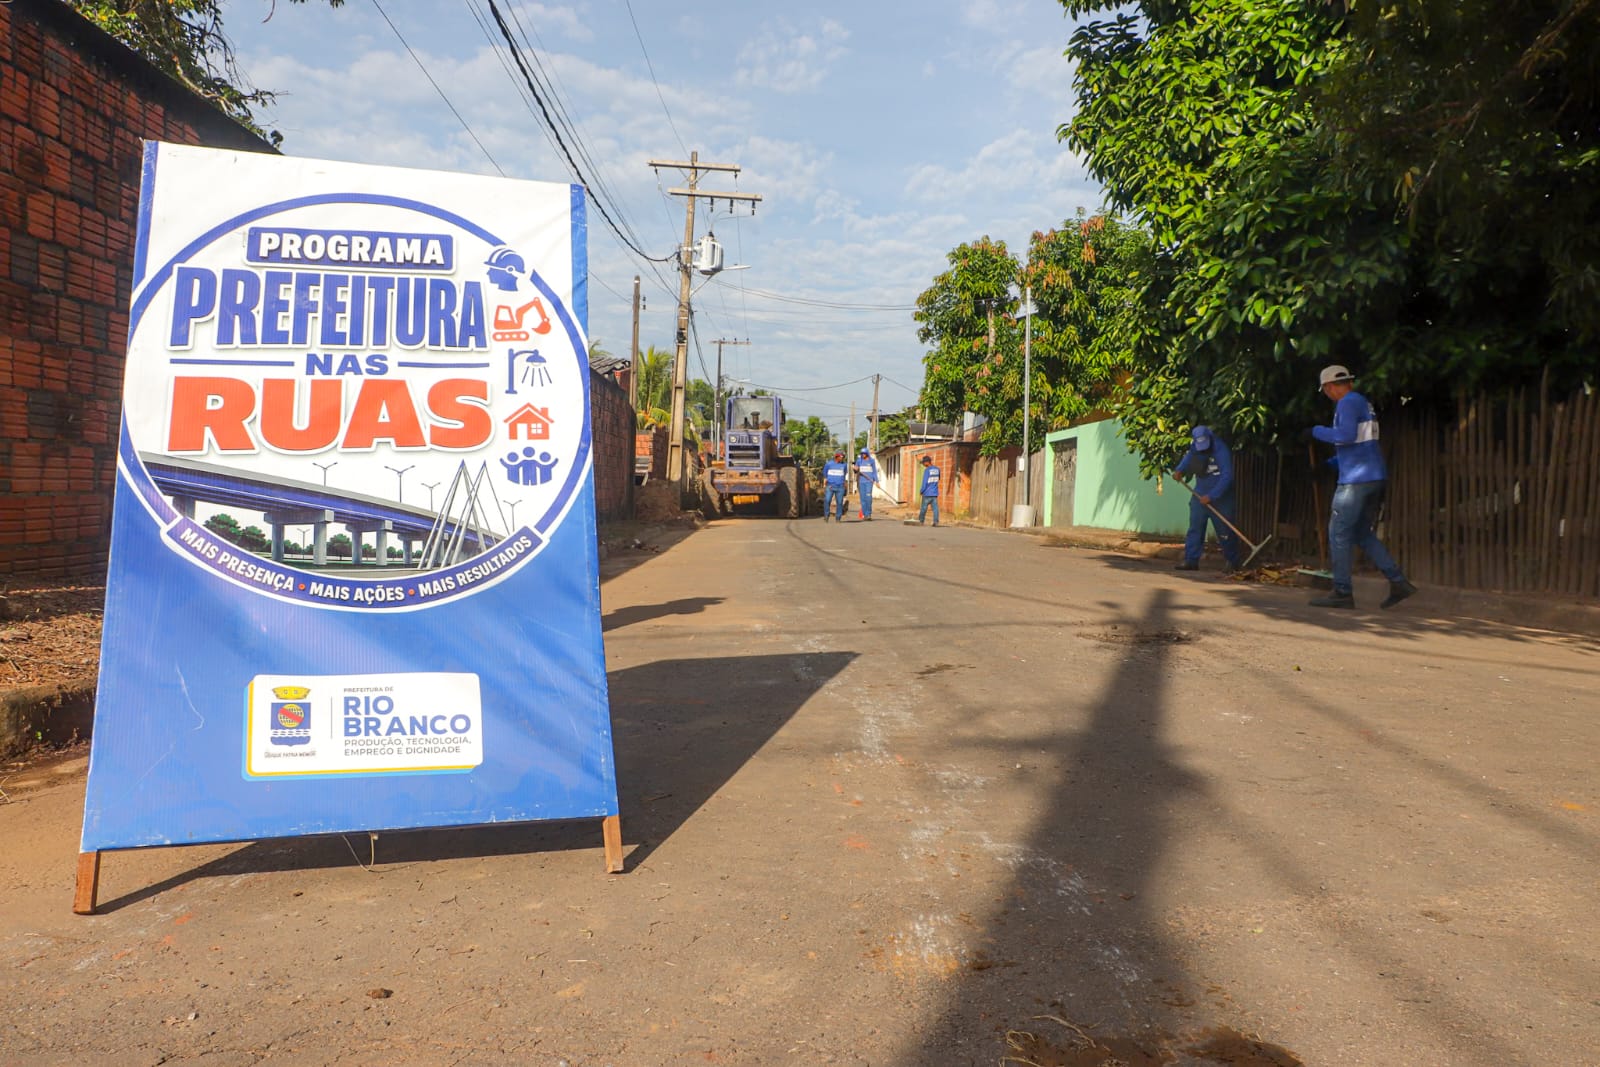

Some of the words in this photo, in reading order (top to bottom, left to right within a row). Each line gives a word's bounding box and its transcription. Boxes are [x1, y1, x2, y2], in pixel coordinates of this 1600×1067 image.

[258, 233, 445, 265] PROGRAMA
[170, 266, 488, 349] PREFEITURA
[306, 353, 389, 376] NAS
[167, 376, 492, 452] RUAS
[180, 527, 219, 563] MAIS
[218, 552, 294, 593] PRESENÇA
[309, 581, 349, 601] MAIS
[354, 584, 405, 605] AÇÕES
[418, 578, 456, 597] MAIS
[455, 535, 532, 585] RESULTADOS
[344, 696, 394, 715] RIO
[344, 714, 471, 737] BRANCO
[345, 737, 403, 747] PRODUÇÃO,
[407, 737, 471, 745] TECNOLOGIA,
[345, 748, 394, 756] EMPREGO
[397, 747, 402, 755] E
[406, 746, 461, 755] DIGNIDADE
